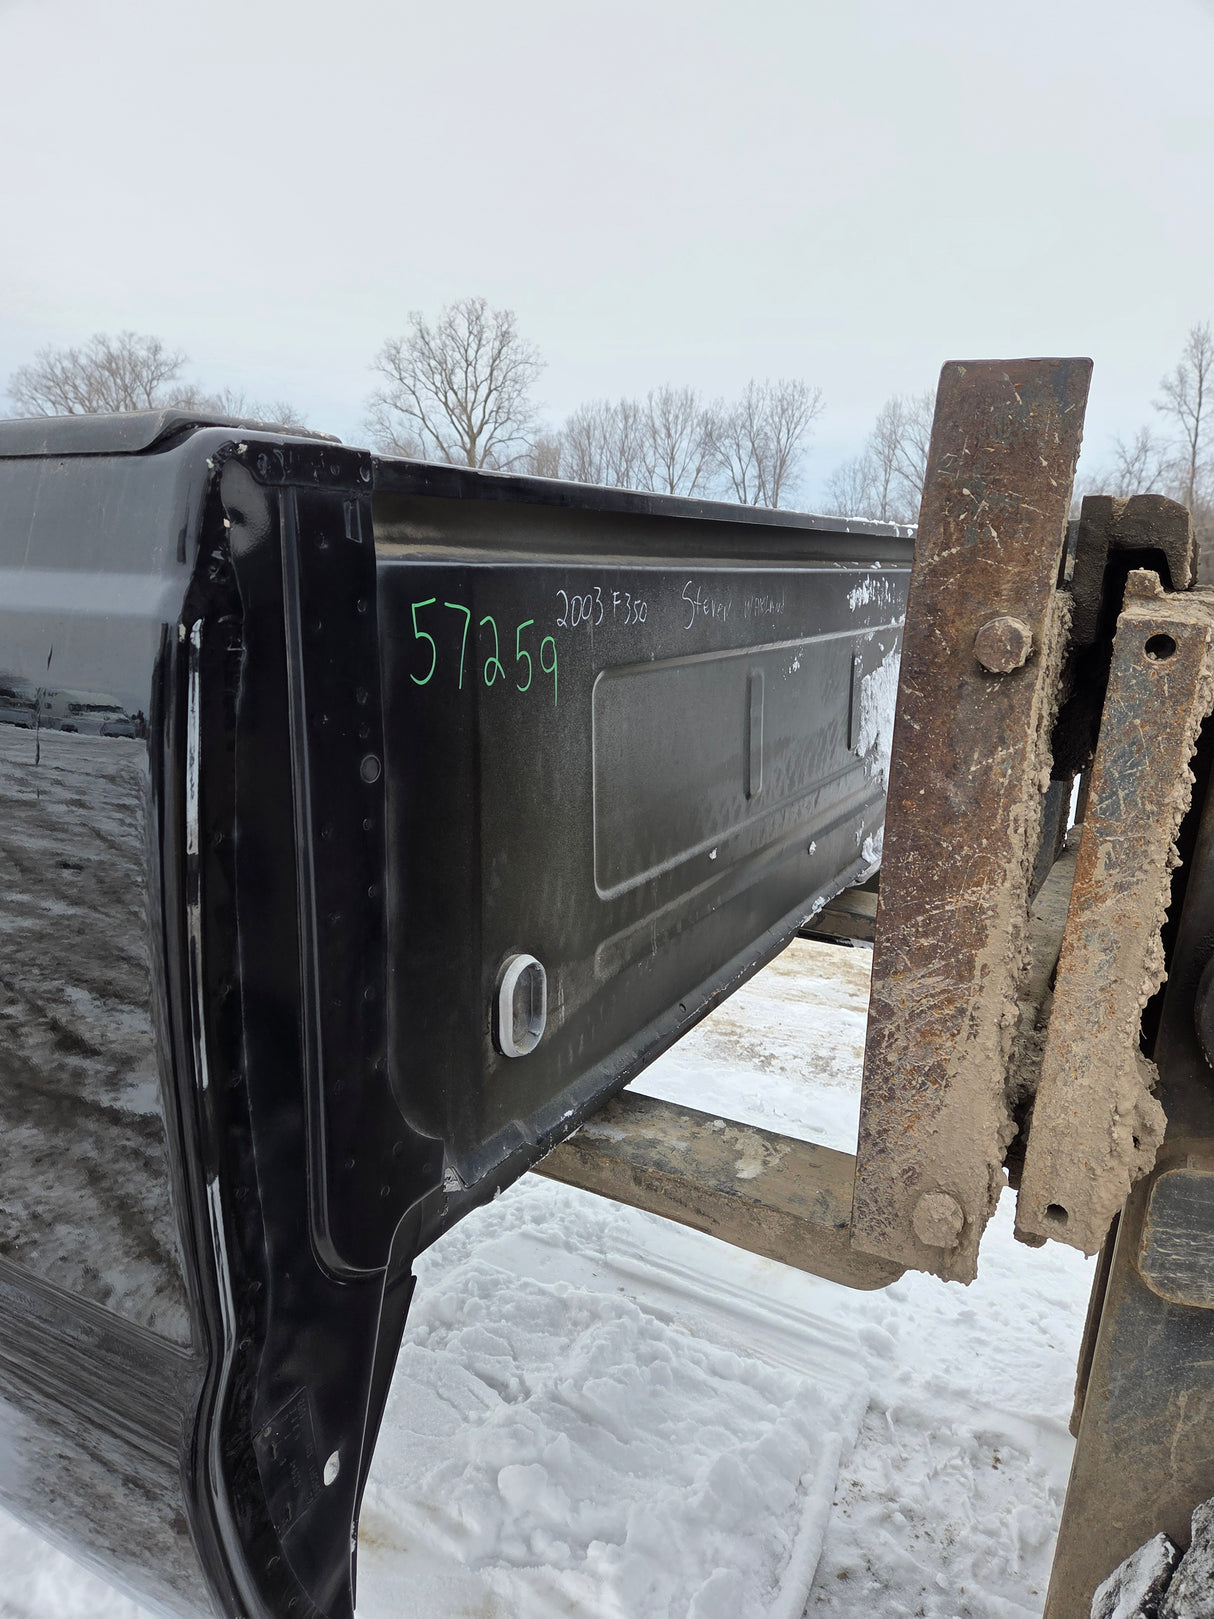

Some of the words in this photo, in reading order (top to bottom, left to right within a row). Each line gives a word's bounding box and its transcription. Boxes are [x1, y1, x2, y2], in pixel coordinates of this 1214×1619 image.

[556, 586, 604, 628] 2003
[610, 589, 648, 625] F350
[410, 597, 558, 706] 57259
